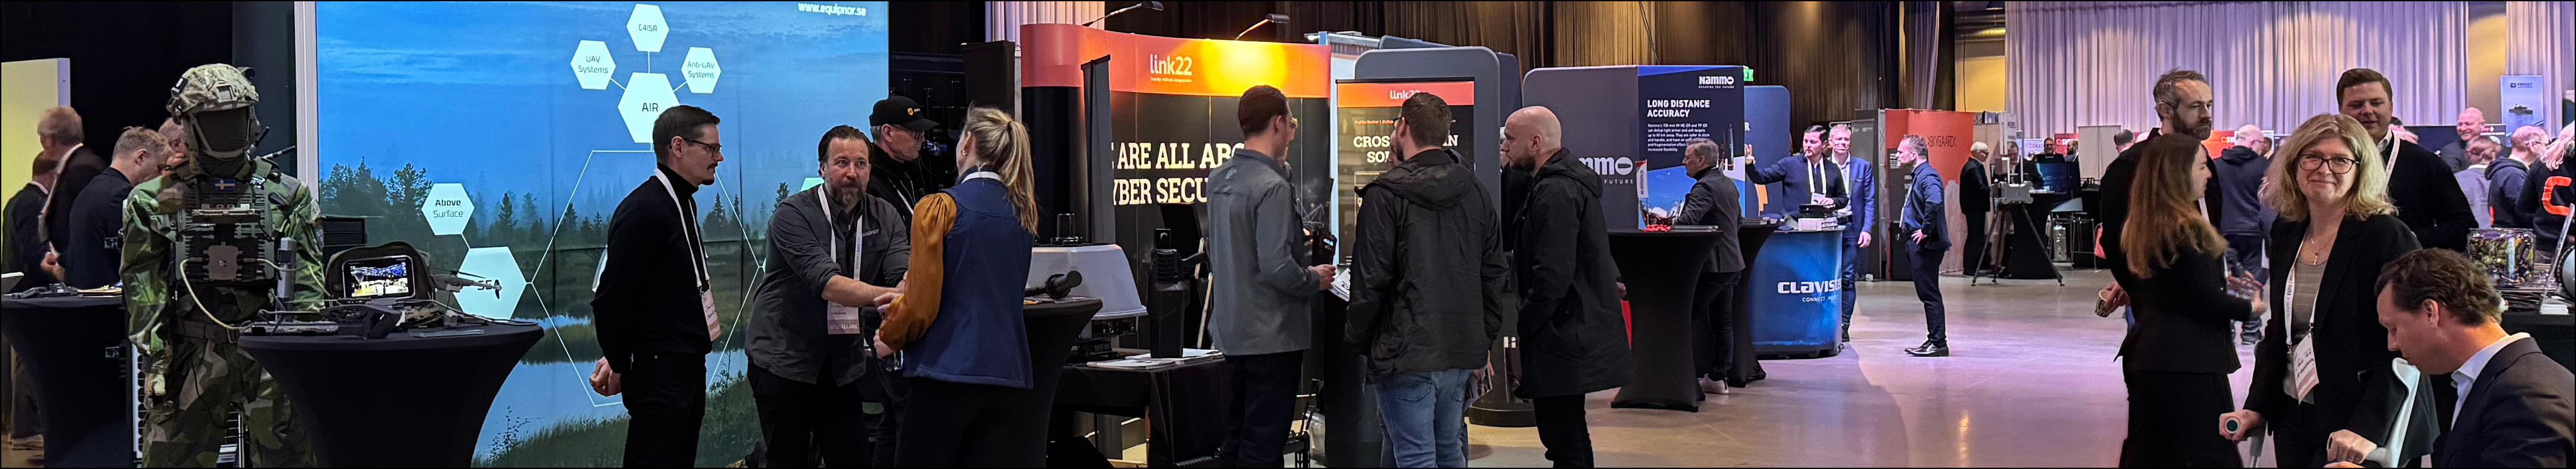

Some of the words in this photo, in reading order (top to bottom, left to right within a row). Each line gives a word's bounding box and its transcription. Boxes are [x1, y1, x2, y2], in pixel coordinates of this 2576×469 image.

[798, 3, 866, 16] www.equipnor.se
[1150, 53, 1192, 75] link22
[578, 65, 608, 73] Systems
[688, 70, 714, 78] Systems
[1699, 76, 1734, 85] Nammo
[641, 102, 658, 112] AIR
[1647, 100, 1669, 108] LONG
[1671, 100, 1710, 108] DISTANCE
[1647, 109, 1690, 118] ACCURACY
[1117, 142, 1151, 169] ARE
[1155, 142, 1195, 169] ALL
